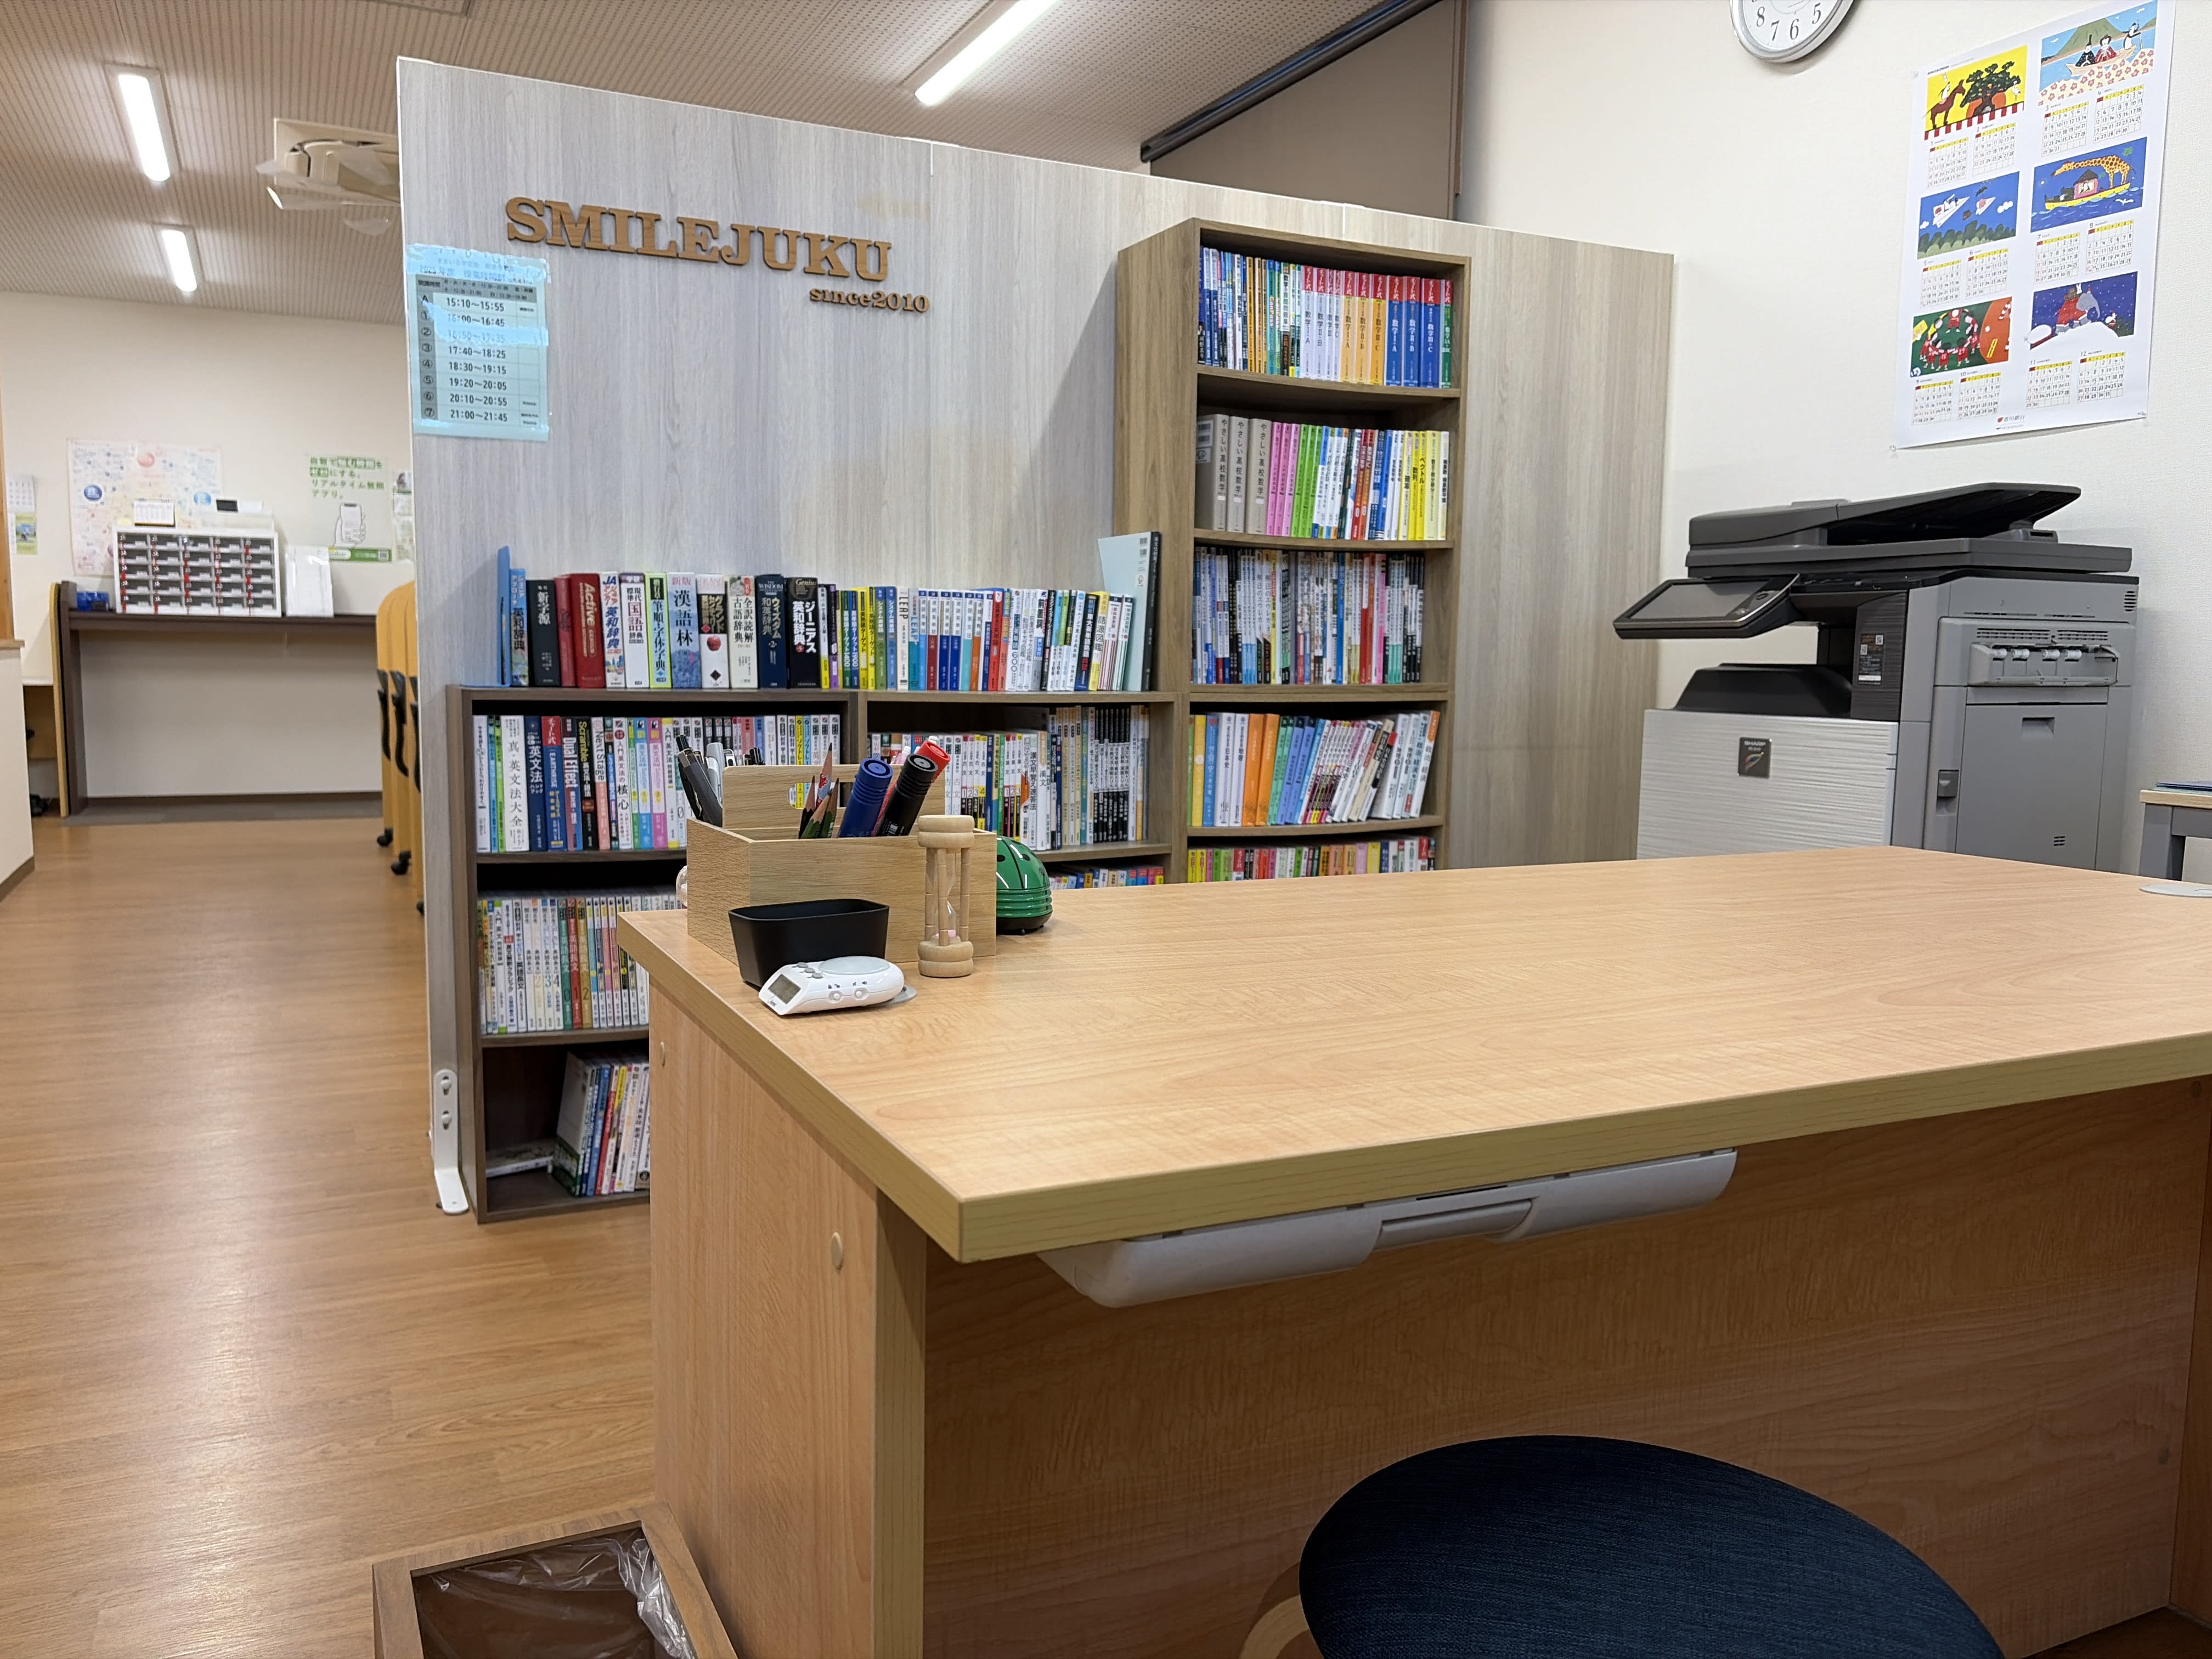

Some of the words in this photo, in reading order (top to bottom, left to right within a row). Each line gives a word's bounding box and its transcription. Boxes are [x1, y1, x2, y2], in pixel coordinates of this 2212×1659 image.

[1756, 7, 1765, 27] 8
[1771, 20, 1780, 41] 7
[1790, 19, 1799, 40] 6
[1812, 2, 1821, 24] 5
[505, 196, 892, 282] SMILEJUKU
[1219, 419, 1228, 492] やさしい高校数学
[1234, 421, 1244, 494] やさしい高校数学
[1257, 424, 1267, 495] やさしい高校数学
[603, 576, 617, 585] JA
[585, 583, 597, 627] Active
[674, 589, 693, 647] 漢語林
[733, 597, 743, 644] 古語辞典
[743, 597, 754, 644] 全訳読解
[771, 597, 782, 640] ウィズダム
[792, 601, 805, 646] 英和辞典
[899, 596, 909, 619] LEAP
[605, 606, 619, 649] 英和辞典
[804, 601, 817, 654] ジーニアス
[1094, 616, 1106, 651] 語源図鑑
[579, 721, 589, 762] Scramble
[509, 740, 523, 827] 真・英文法大全
[529, 746, 544, 783] 英文法
[1039, 770, 1047, 787] 漢文
[545, 974, 551, 987] 3
[553, 974, 560, 987] 4
